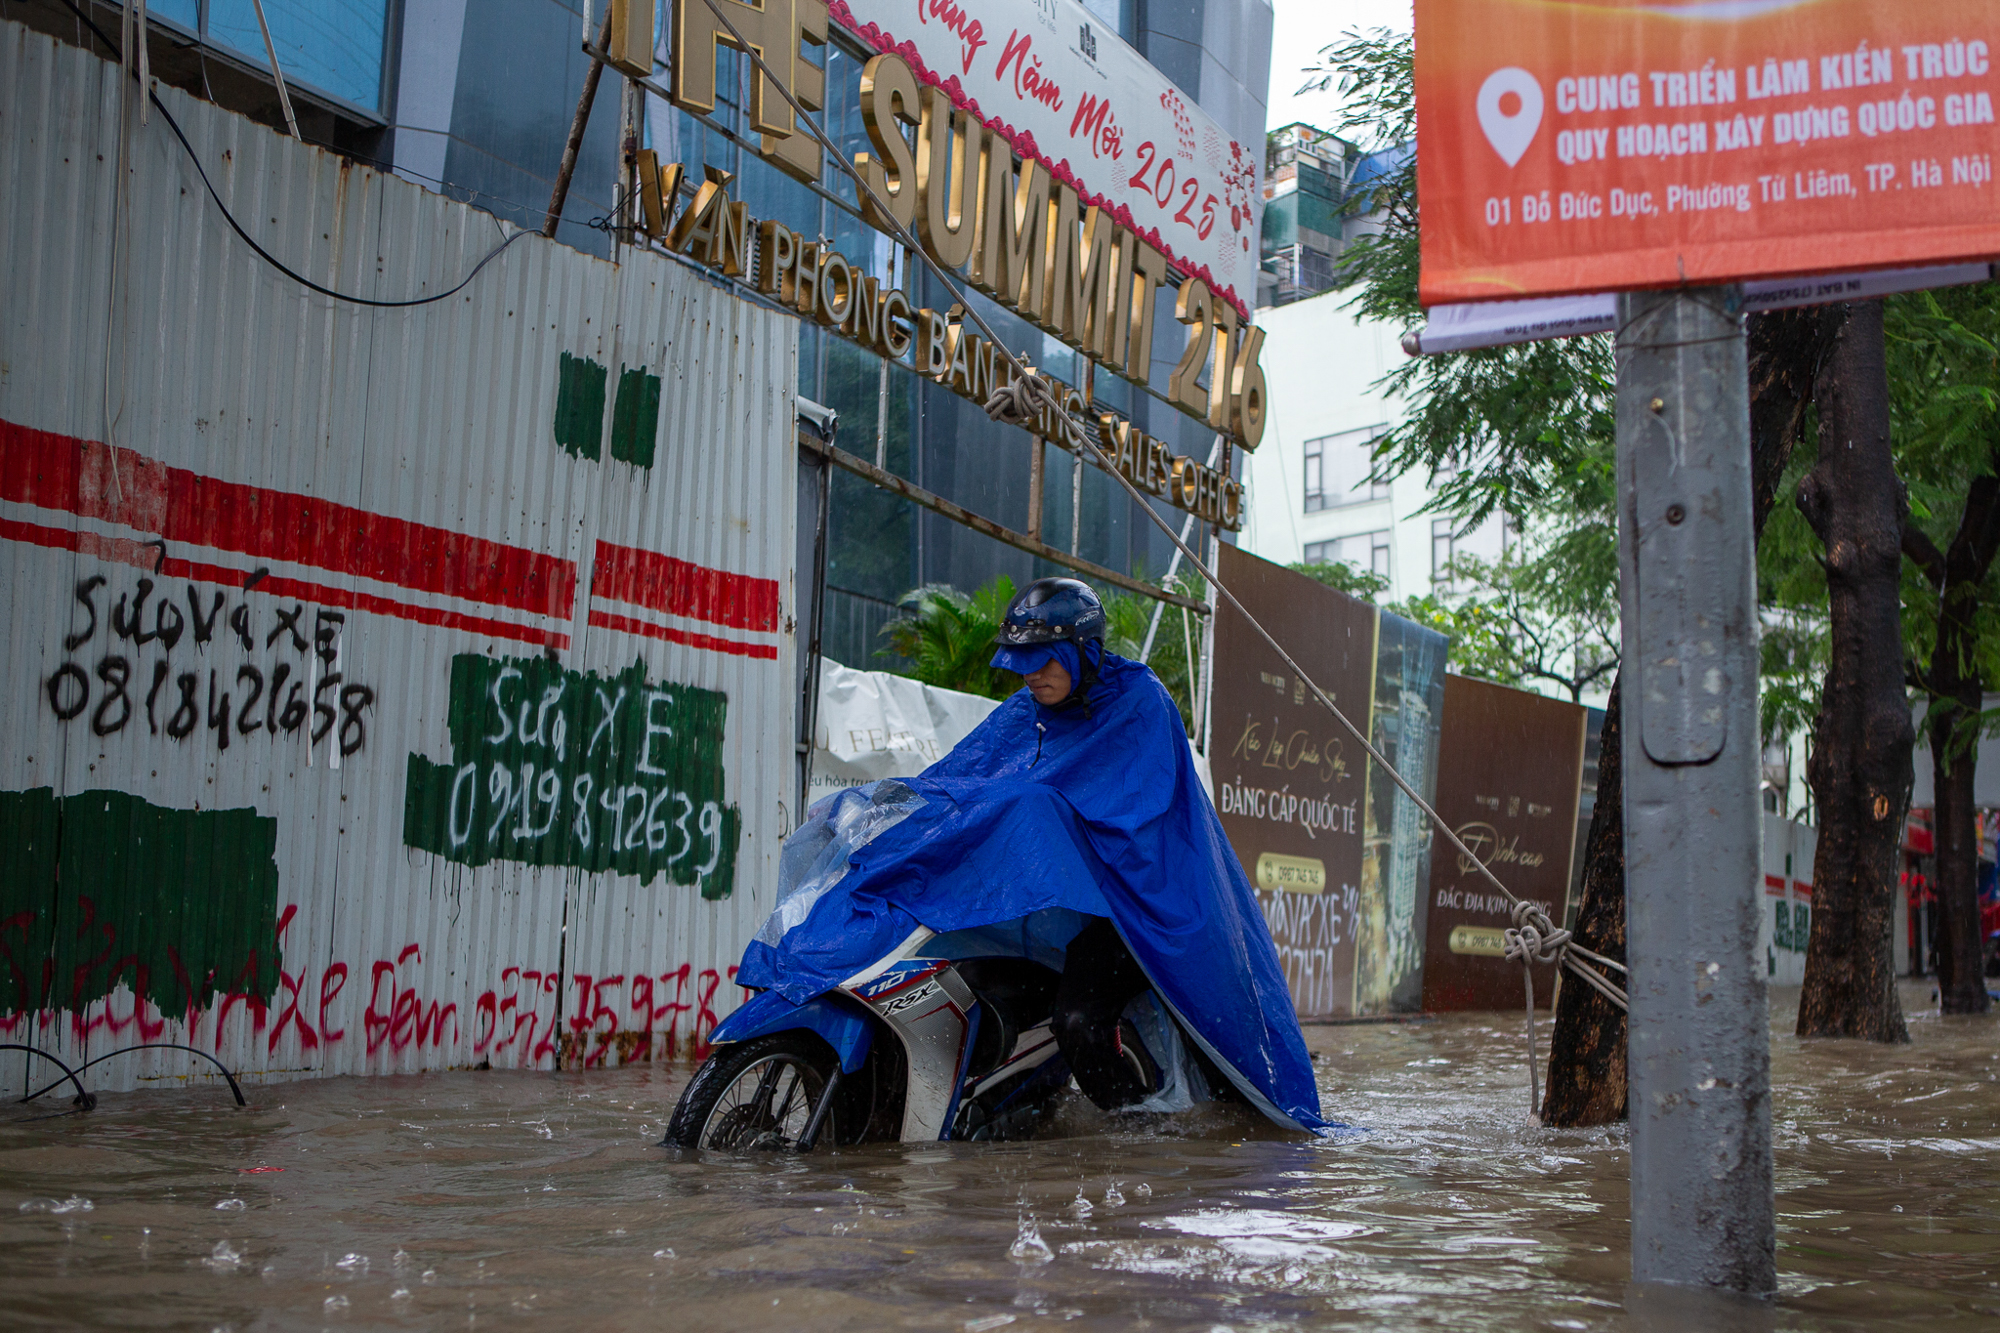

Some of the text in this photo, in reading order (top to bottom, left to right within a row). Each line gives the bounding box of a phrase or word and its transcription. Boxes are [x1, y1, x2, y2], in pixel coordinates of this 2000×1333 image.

[1556, 76, 1640, 114] CUNG
[1649, 57, 1736, 107] TRIỂN
[1820, 39, 1892, 91] KIẾN
[1902, 37, 1989, 80] TRÚC
[996, 28, 1064, 112] Năm
[1070, 91, 1124, 161] Mới
[1129, 140, 1220, 241] 2025
[1556, 89, 1995, 165] QUY HOẠCH XÂY DỰNG QUỐC GIA
[1485, 197, 1511, 227] 01
[1559, 191, 1602, 221] Đức
[1610, 188, 1659, 220] Dục,
[1667, 182, 1751, 213] Phường
[1758, 174, 1786, 203] Từ
[1794, 170, 1857, 199] Liêm,
[1865, 163, 1902, 192] TP.
[1911, 159, 1943, 188] Hà
[1952, 154, 1991, 189] Nội
[855, 52, 1167, 387] SUMMIT
[1169, 277, 1268, 454] 216
[916, 303, 999, 404] BÁN
[1099, 412, 1172, 495] SALES
[1172, 455, 1245, 532] OFFICE
[825, 774, 848, 788] hòa
[1221, 775, 1357, 840] ĐẲNG CẤP QUỐC TẾ
[1519, 853, 1544, 868] cao
[867, 970, 908, 997] 110
[878, 979, 942, 1019] RSX
